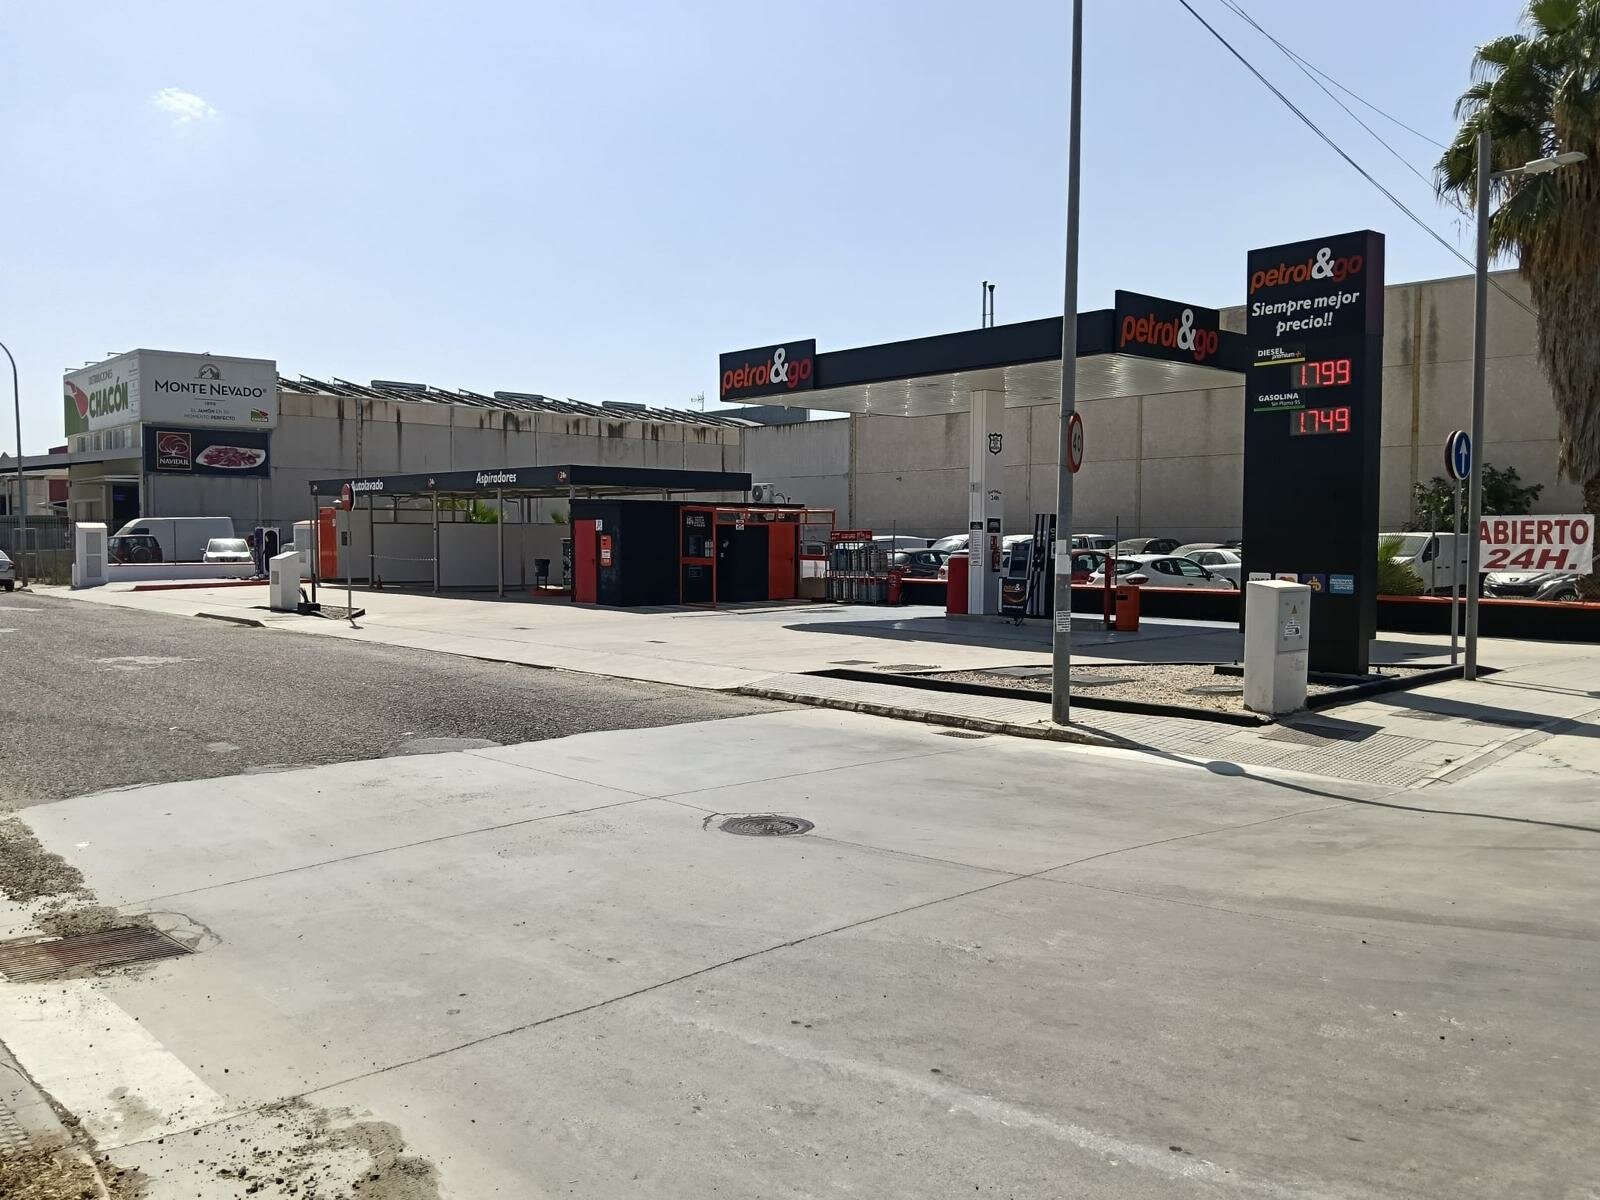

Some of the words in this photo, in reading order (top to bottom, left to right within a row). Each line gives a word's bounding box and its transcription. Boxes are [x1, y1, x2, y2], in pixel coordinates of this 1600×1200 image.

[1250, 247, 1363, 295] petrol&go
[1252, 299, 1311, 317] Siempre
[1313, 291, 1360, 310] mejor
[1120, 308, 1219, 361] petrol&go
[1276, 311, 1334, 337] precio!!
[1257, 347, 1285, 357] DIESEL
[722, 347, 812, 396] petrol&go
[89, 376, 129, 418] CHACÓN
[154, 379, 208, 395] MONTE
[1258, 392, 1300, 402] GASOLINA
[159, 458, 190, 466] NAVIDUL
[476, 471, 517, 487] Aspiradores
[1480, 520, 1589, 545] ABIERTO
[1483, 548, 1577, 570] 24H.
